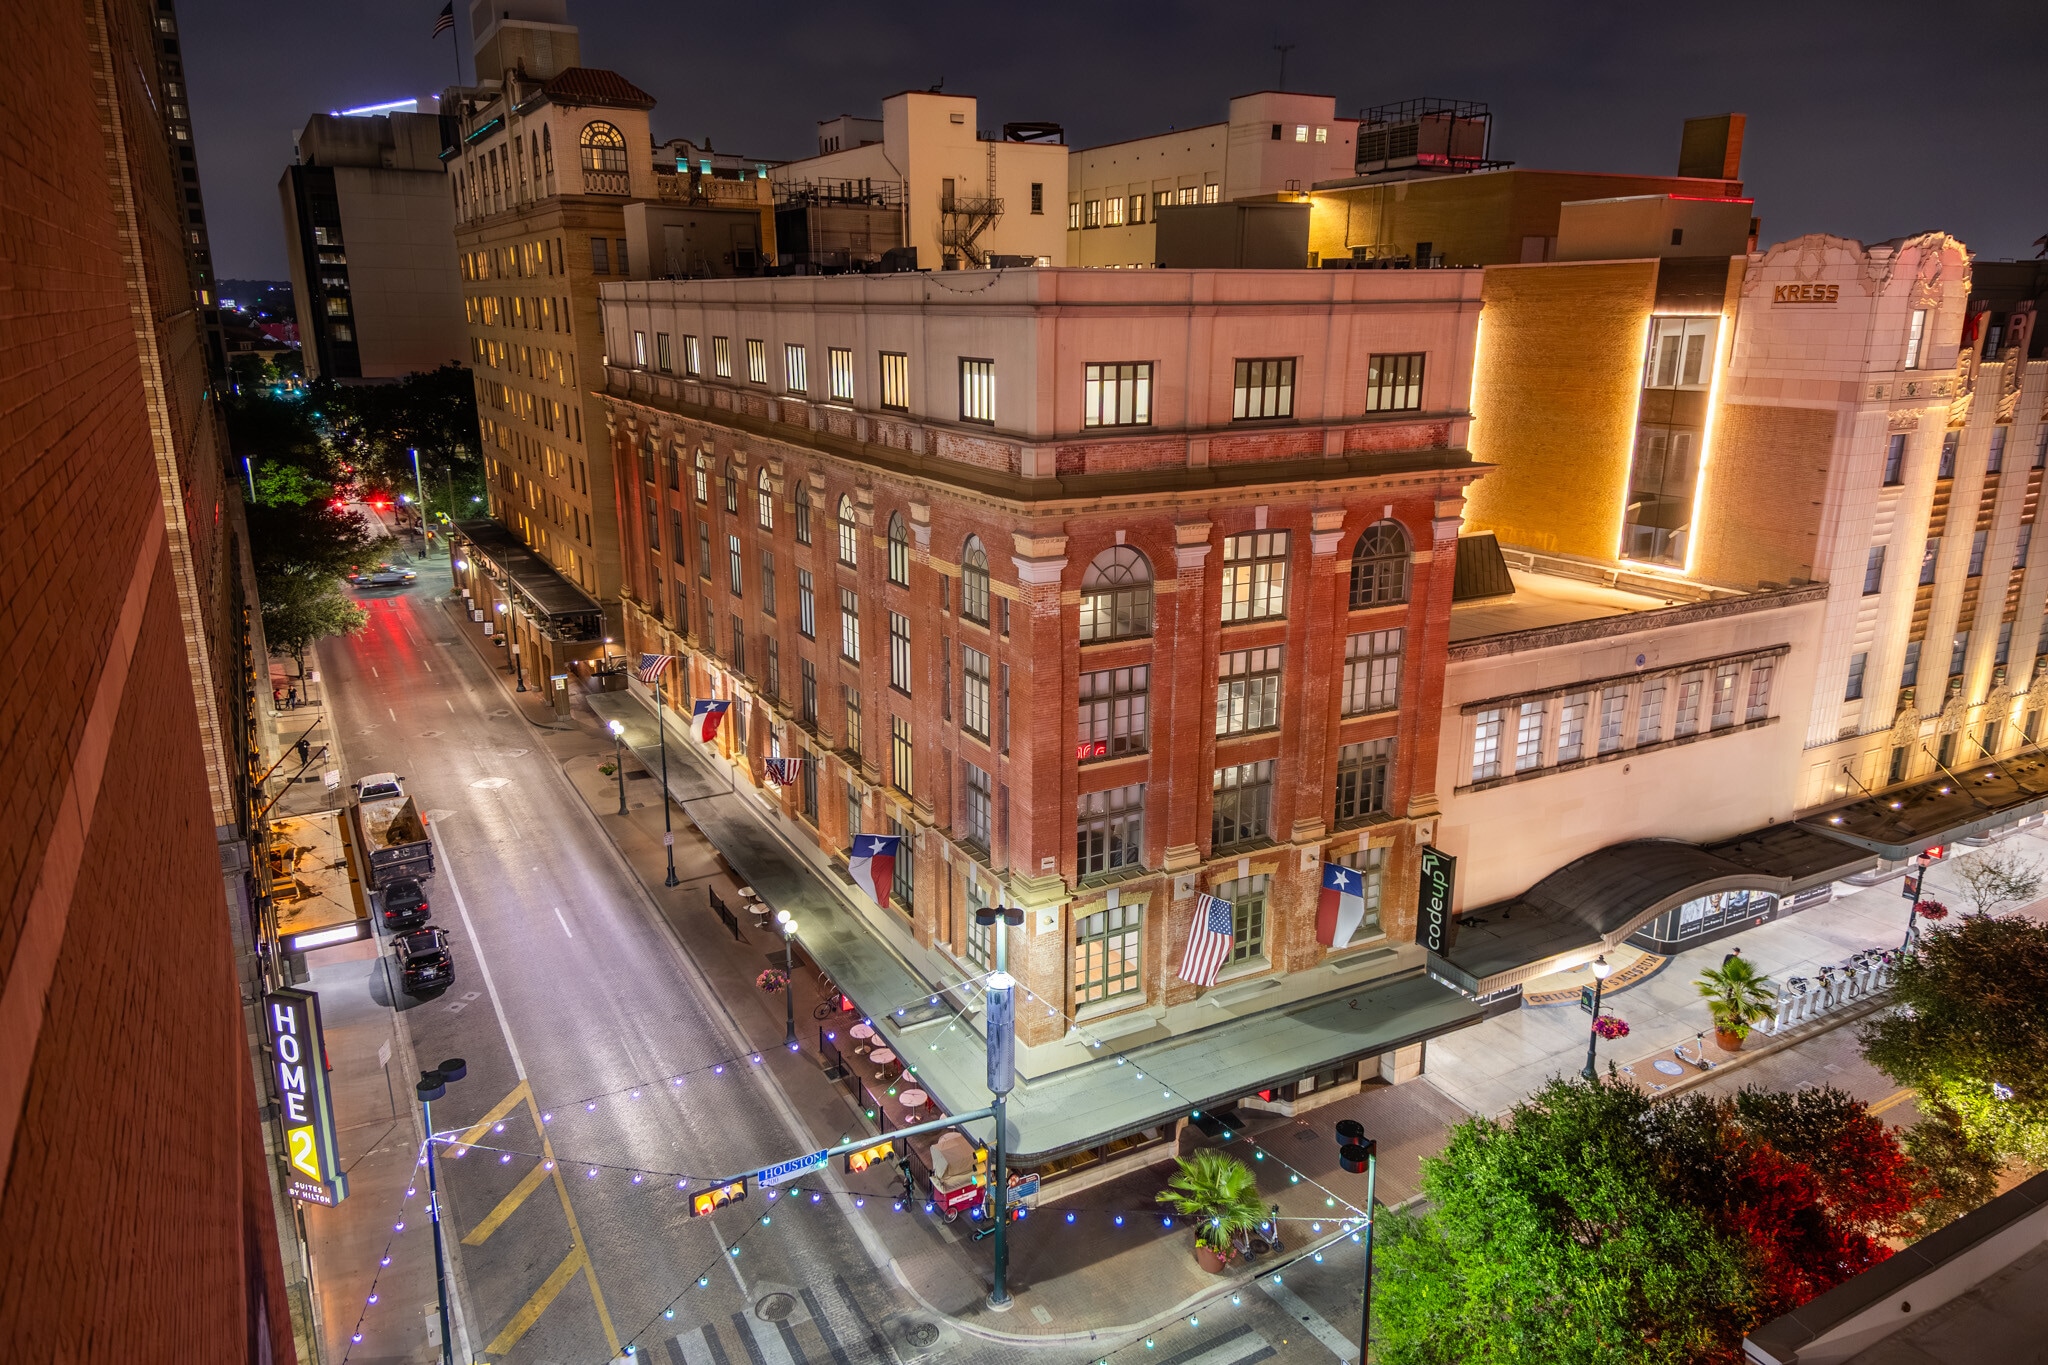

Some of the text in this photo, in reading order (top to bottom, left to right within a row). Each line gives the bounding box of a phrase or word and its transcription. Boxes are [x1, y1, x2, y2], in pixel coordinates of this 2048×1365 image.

[1774, 284, 1839, 301] KRESS
[1426, 870, 1449, 950] codeup
[1529, 979, 1619, 1003] CHILDN'S
[1618, 955, 1661, 982] MUSEUM
[272, 1003, 308, 1122] HOME
[292, 1130, 317, 1176] 2
[764, 1151, 823, 1179] HOUSTON
[289, 1188, 331, 1204] BY HILTON
[294, 1181, 323, 1194] SUITES
